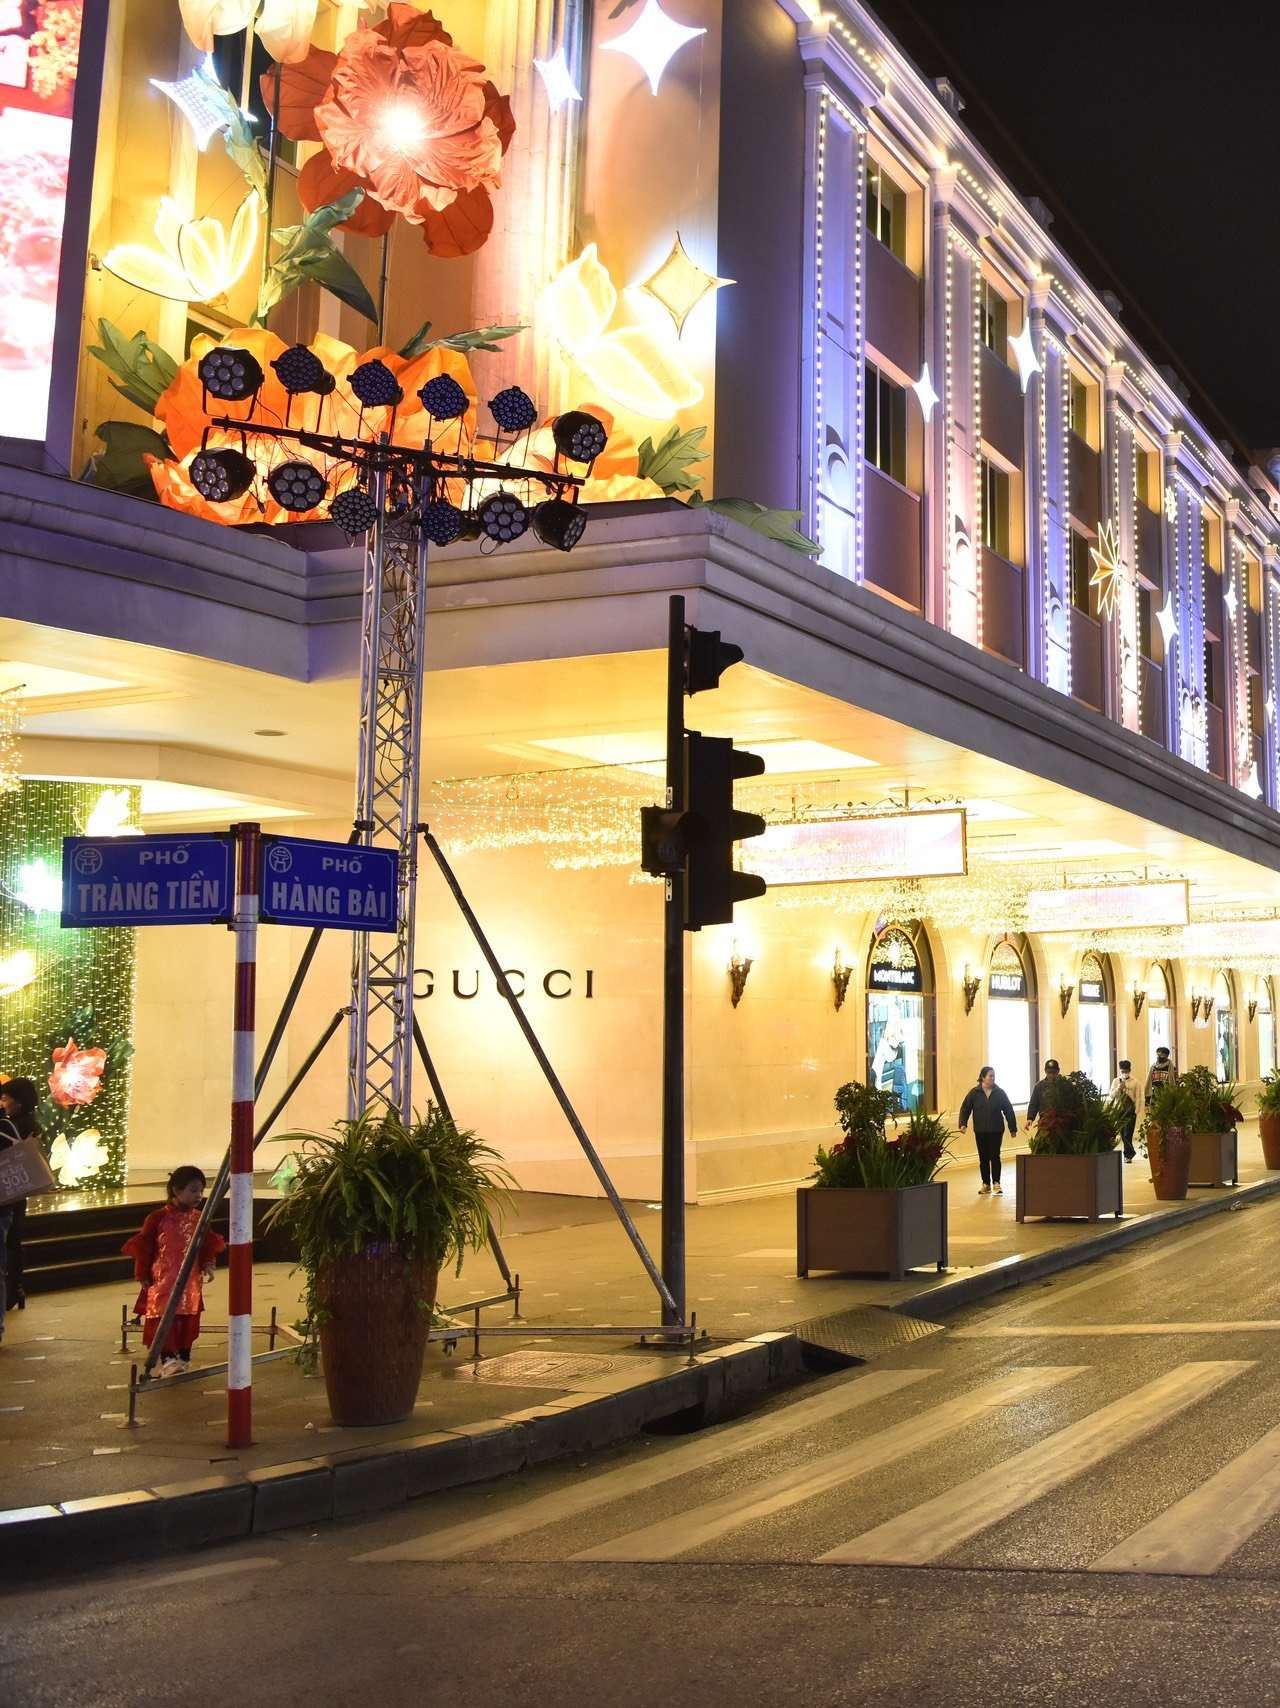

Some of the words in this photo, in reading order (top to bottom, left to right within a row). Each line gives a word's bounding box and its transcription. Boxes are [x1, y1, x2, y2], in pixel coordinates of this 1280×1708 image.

[139, 844, 191, 865] PHỐ
[322, 855, 363, 874] PHỐ
[78, 876, 159, 913] TRÀNG
[166, 870, 219, 910] TIỀN
[272, 875, 340, 914] HÀNG
[348, 884, 386, 918] BÀI
[412, 968, 594, 999] GUCCI
[991, 975, 1021, 991] HUBLOT
